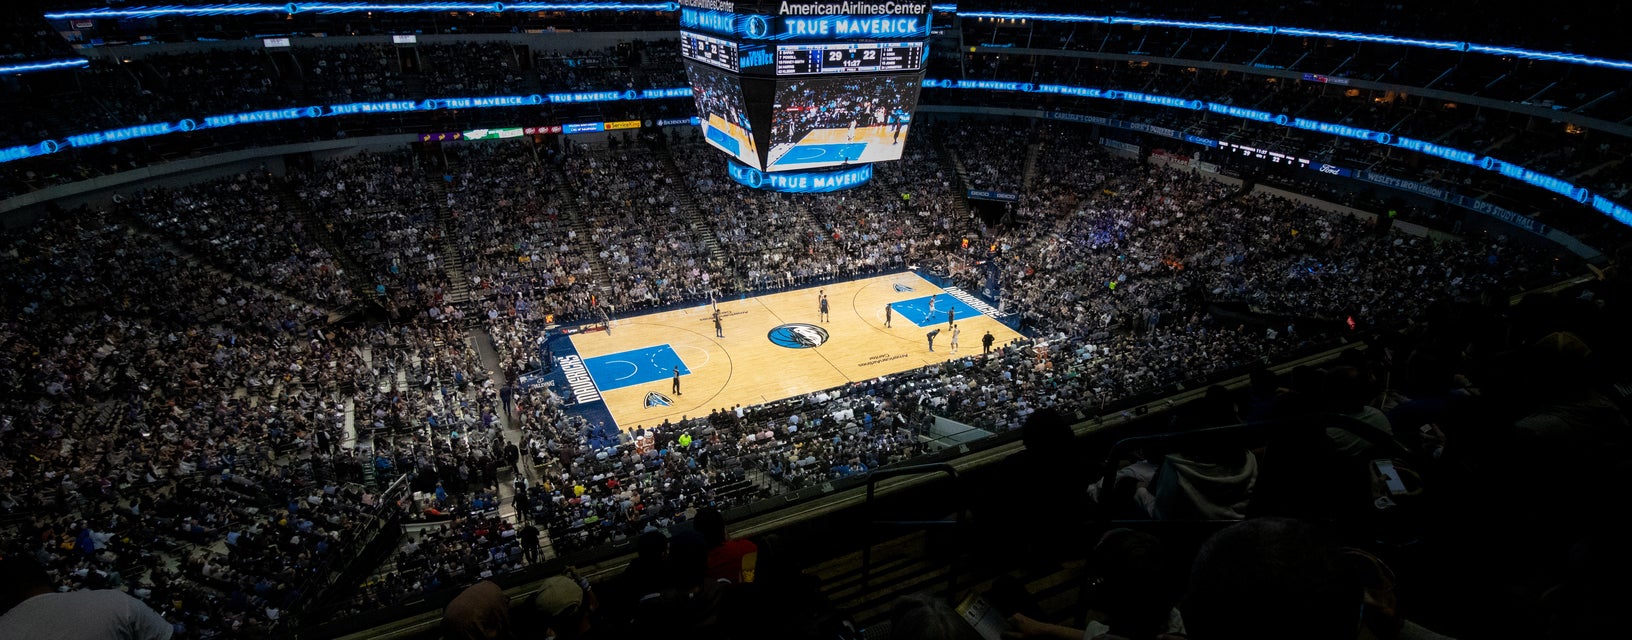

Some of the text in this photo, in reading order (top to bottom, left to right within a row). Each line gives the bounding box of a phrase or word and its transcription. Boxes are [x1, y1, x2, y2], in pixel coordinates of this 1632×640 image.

[779, 0, 926, 15] AmericanAirlinesCenter
[682, 8, 735, 33] TRUE MAVERICK
[785, 18, 917, 35] TRUE MAVERICK
[740, 53, 774, 68] MAVERICK
[829, 51, 843, 61] 29
[862, 50, 876, 60] 22
[642, 89, 664, 98] TRUE
[957, 80, 1017, 91] TRUE MAVERICK
[1039, 83, 1101, 97] TRUE MAVERICK
[446, 95, 522, 108] TRUE MAVERICK
[549, 91, 619, 103] TRUE MAVERICK
[1124, 92, 1185, 107] TRUE MAVERICK
[331, 100, 416, 114] TRUE MAVERICK
[1208, 102, 1271, 121] TRUE MAVERICK
[205, 108, 299, 127] TRUE MAVERICK
[69, 122, 169, 147] TRUE MAVERICK
[1294, 118, 1370, 140] TRUE MAVERICK
[1398, 137, 1476, 164] TRUE MAVERICK
[770, 167, 871, 188] TRUE MAVERICK
[1320, 163, 1340, 176] Ford
[1367, 172, 1401, 187] WESLEY'S
[1418, 183, 1442, 198] LEGION
[1499, 161, 1573, 197] TRUE MAVERICK
[1473, 199, 1536, 230] DP'S STUDY HALL
[557, 354, 601, 404] MAVERICKS
